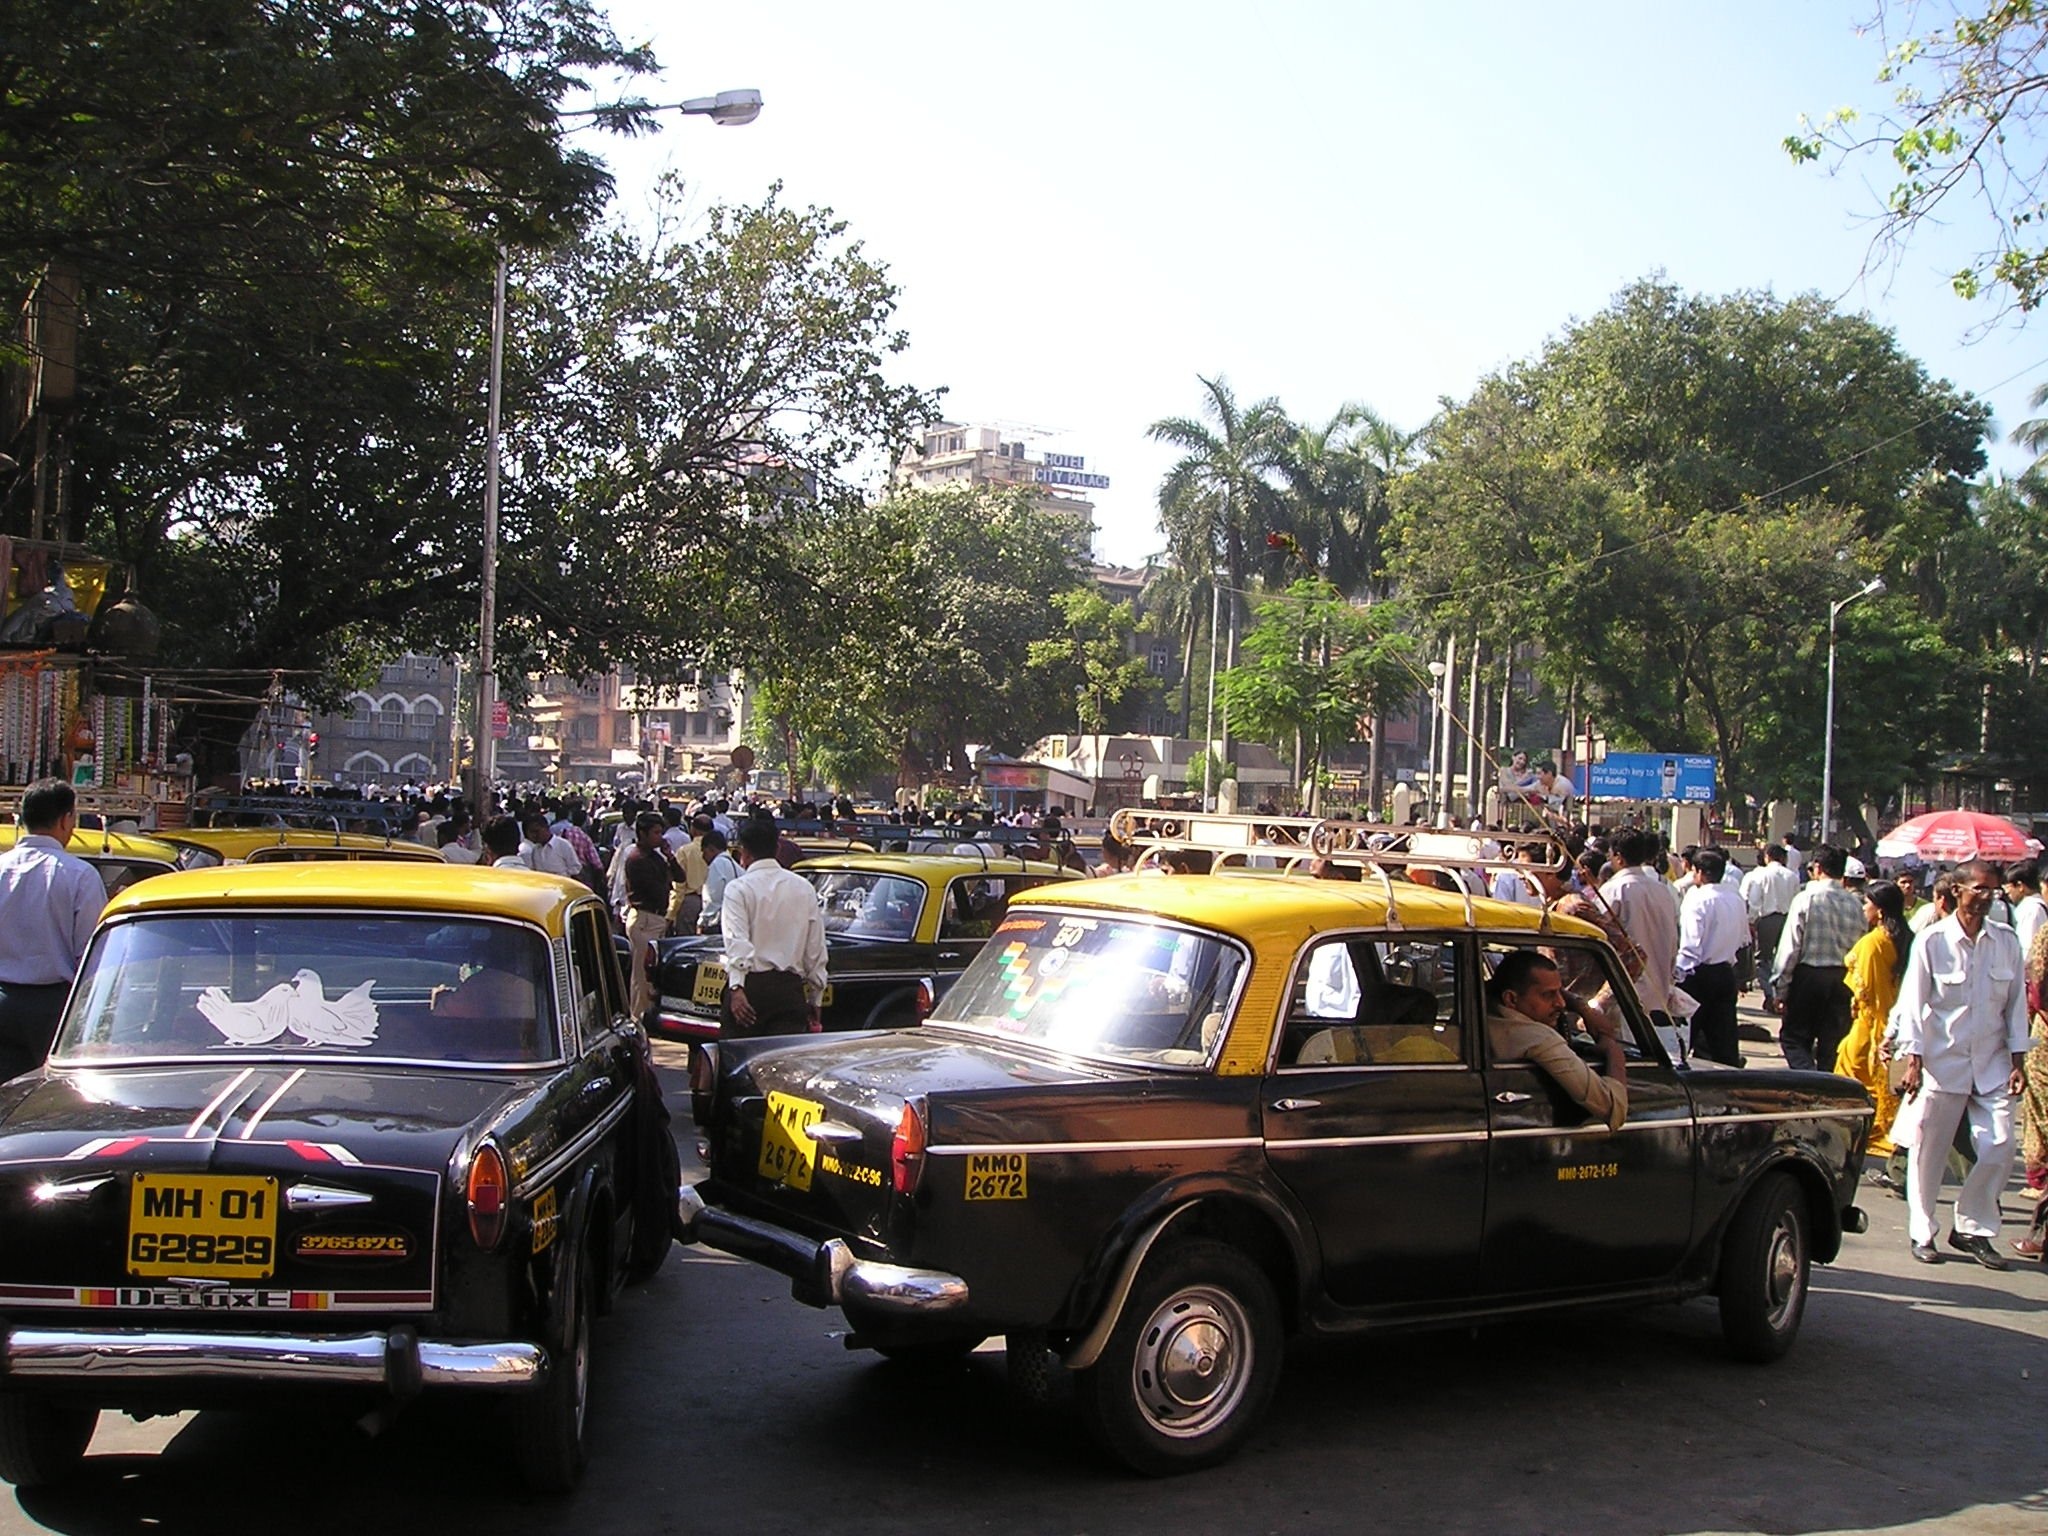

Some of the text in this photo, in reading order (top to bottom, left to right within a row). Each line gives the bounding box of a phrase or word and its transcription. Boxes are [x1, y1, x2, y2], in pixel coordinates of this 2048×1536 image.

[1044, 453, 1084, 469] HOTEL
[1036, 468, 1109, 488] CITY PALACE
[1684, 757, 1712, 765] NOKIA
[1592, 767, 1609, 775] One
[1609, 767, 1631, 776] touch
[1632, 768, 1644, 777] key
[1592, 776, 1627, 785] FM Radio
[703, 966, 718, 979] MH
[765, 1140, 808, 1178] 2672
[969, 1174, 1024, 1199] 2672
[143, 1187, 265, 1220] MH 01
[131, 1233, 272, 1266] G2829
[120, 1288, 290, 1310] DELUXE
